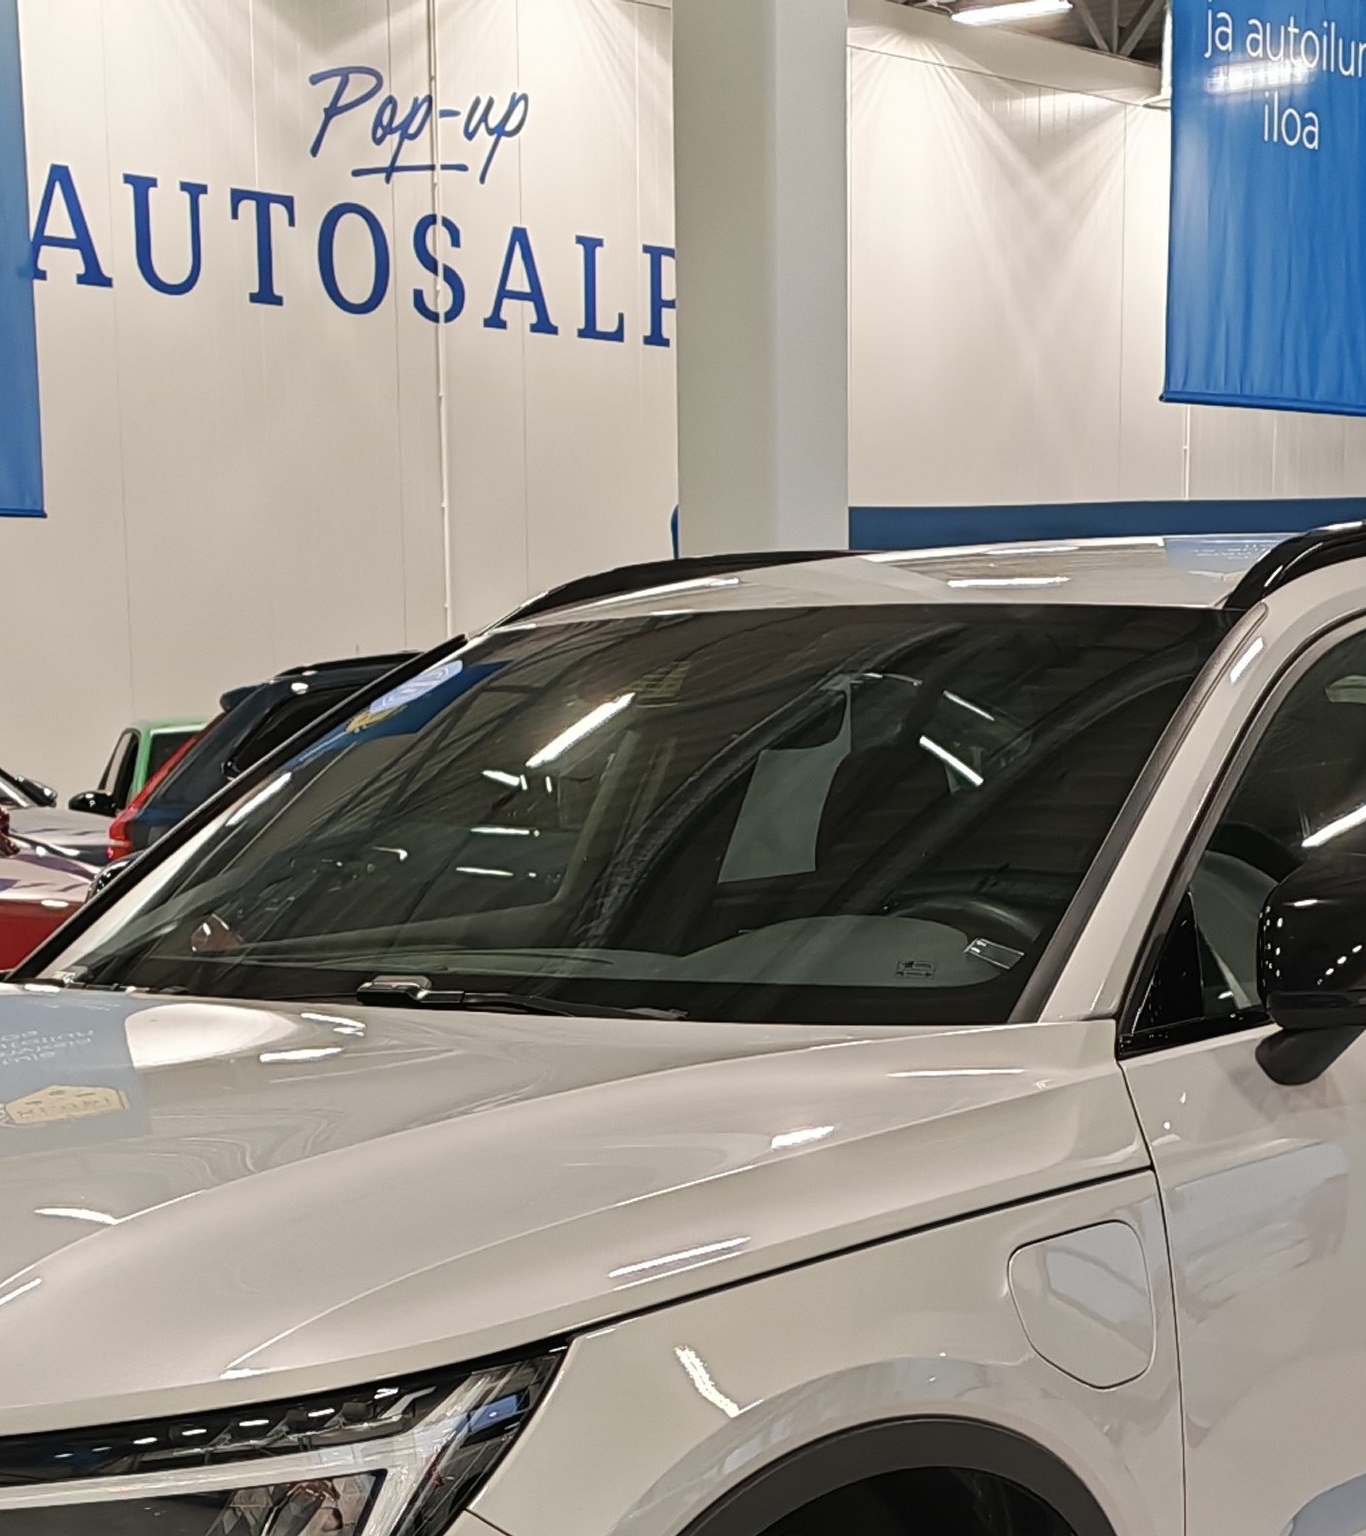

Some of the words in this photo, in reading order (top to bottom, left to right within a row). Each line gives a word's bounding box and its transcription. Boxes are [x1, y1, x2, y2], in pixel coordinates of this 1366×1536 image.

[1204, 0, 1233, 59] ja
[308, 65, 529, 185] Pop-up
[1263, 90, 1319, 150] iloa
